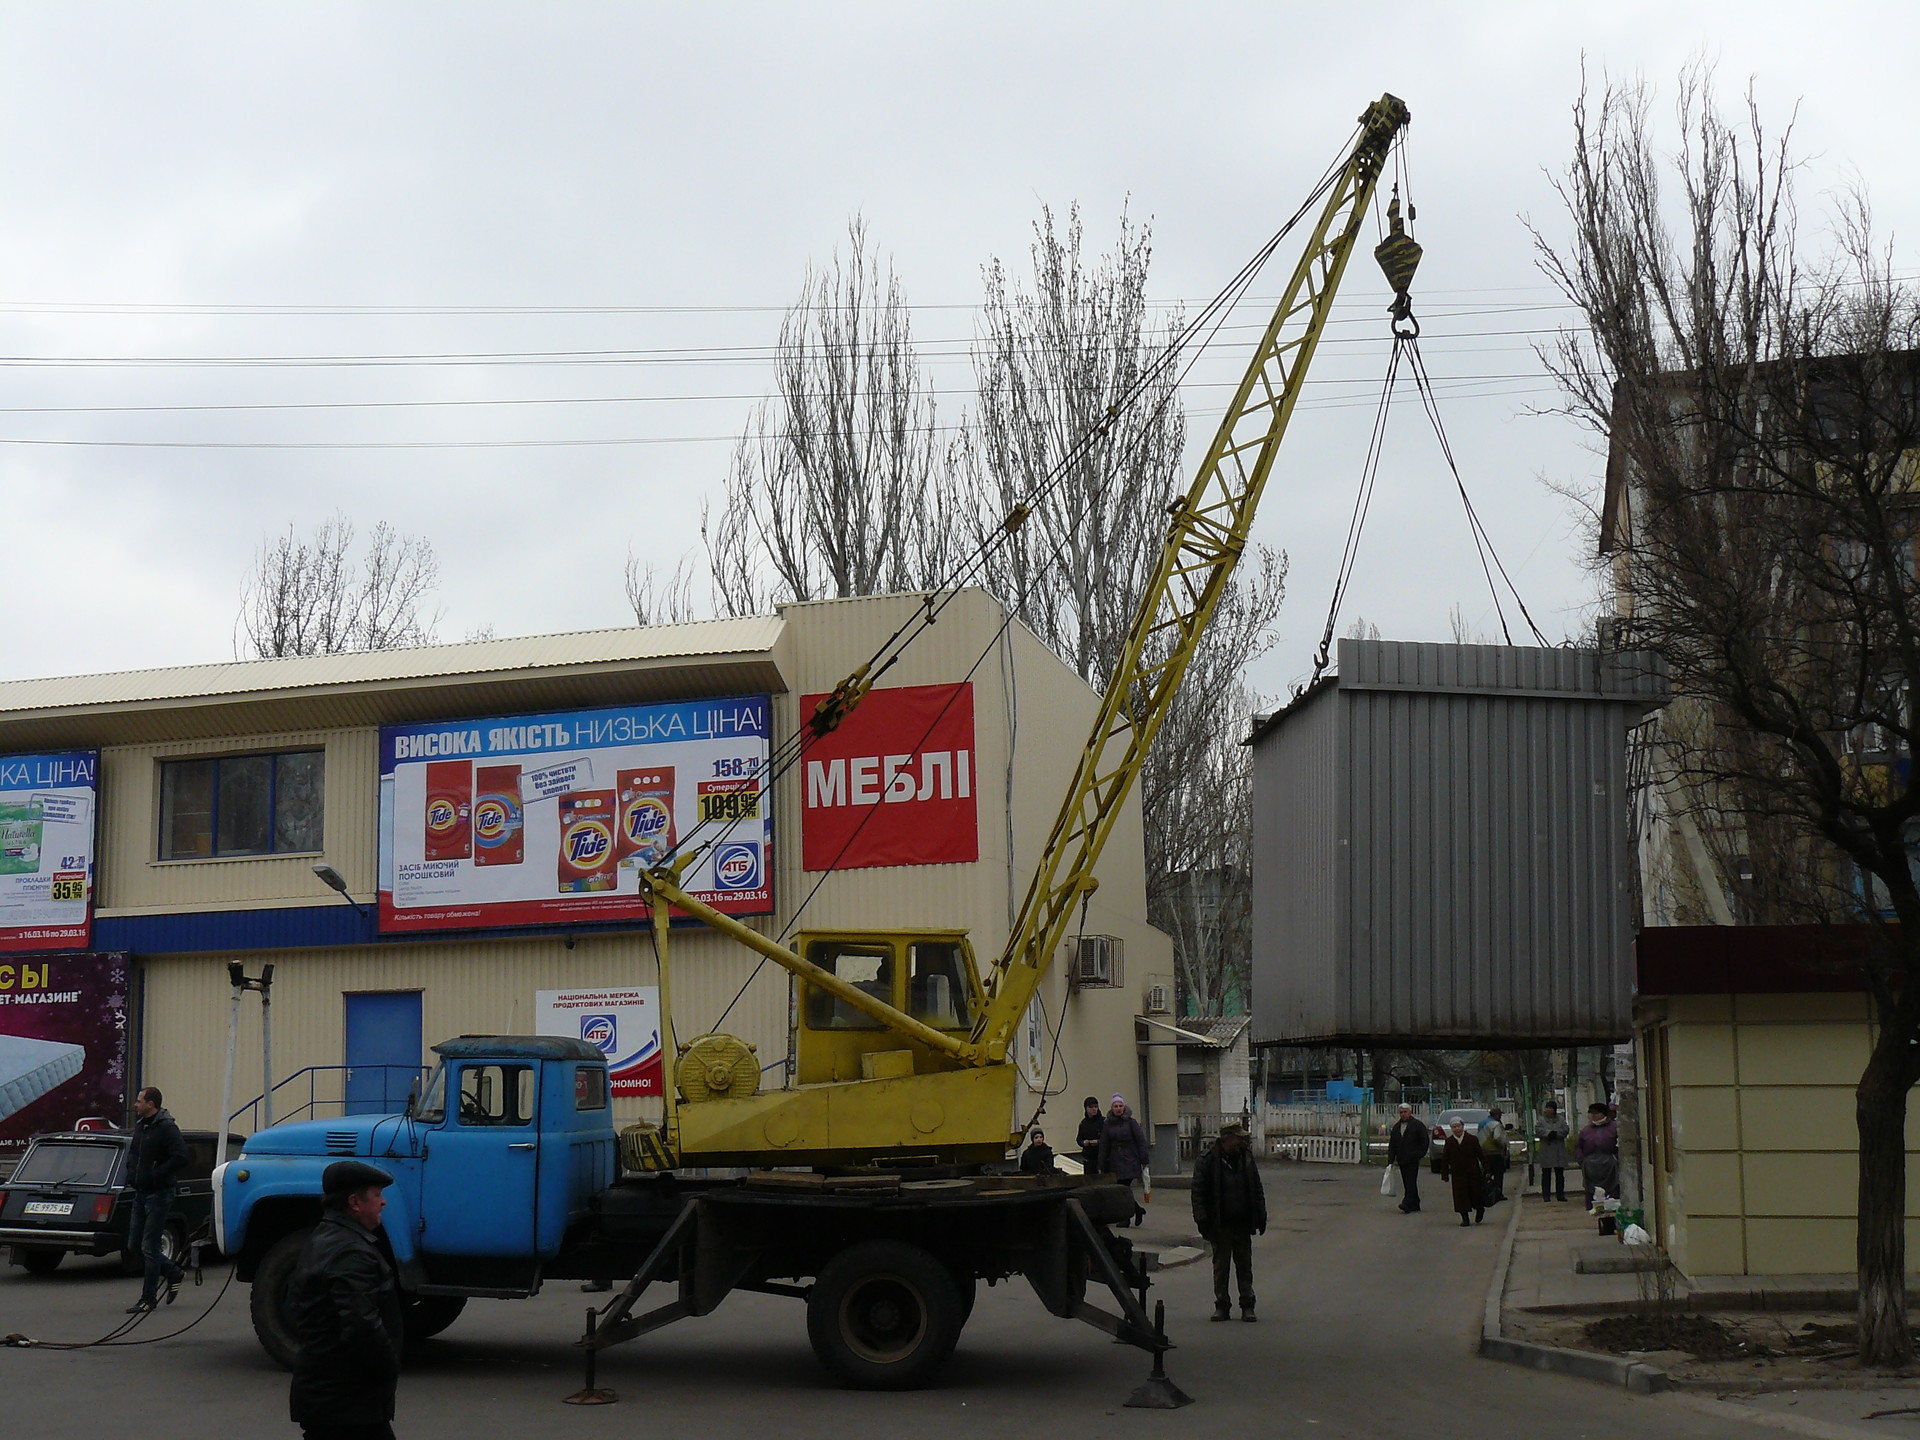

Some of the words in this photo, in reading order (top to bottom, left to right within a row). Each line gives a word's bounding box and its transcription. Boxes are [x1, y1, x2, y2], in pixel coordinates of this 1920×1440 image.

[395, 730, 481, 759] ВИСОКА
[488, 724, 570, 751] ЯКІСТЬ
[575, 713, 686, 745] НИЗЬКА
[693, 706, 762, 739] ЦІНА!
[0, 764, 30, 785] КА
[37, 759, 94, 787] ЦІНА!
[808, 750, 970, 808] МЕБЛІ
[708, 782, 750, 792] Суперціа!
[430, 808, 451, 825] Tide
[479, 810, 502, 830] Tide
[630, 805, 666, 837] Tide
[570, 828, 608, 861] Tide
[399, 863, 421, 872] ЗАСІБ
[423, 860, 459, 870] МИЮЧИЙ
[722, 861, 748, 871] АТБ
[399, 869, 455, 880] ПОРОШКОВИЙ
[72, 881, 83, 891] 95
[733, 891, 768, 901] 29.03.16
[0, 963, 49, 989] СЫ
[558, 993, 608, 1001] НАЦІОНАЛЬНА
[553, 1001, 602, 1009] ПРОДУКТОВИХ
[587, 1030, 608, 1039] АТБ
